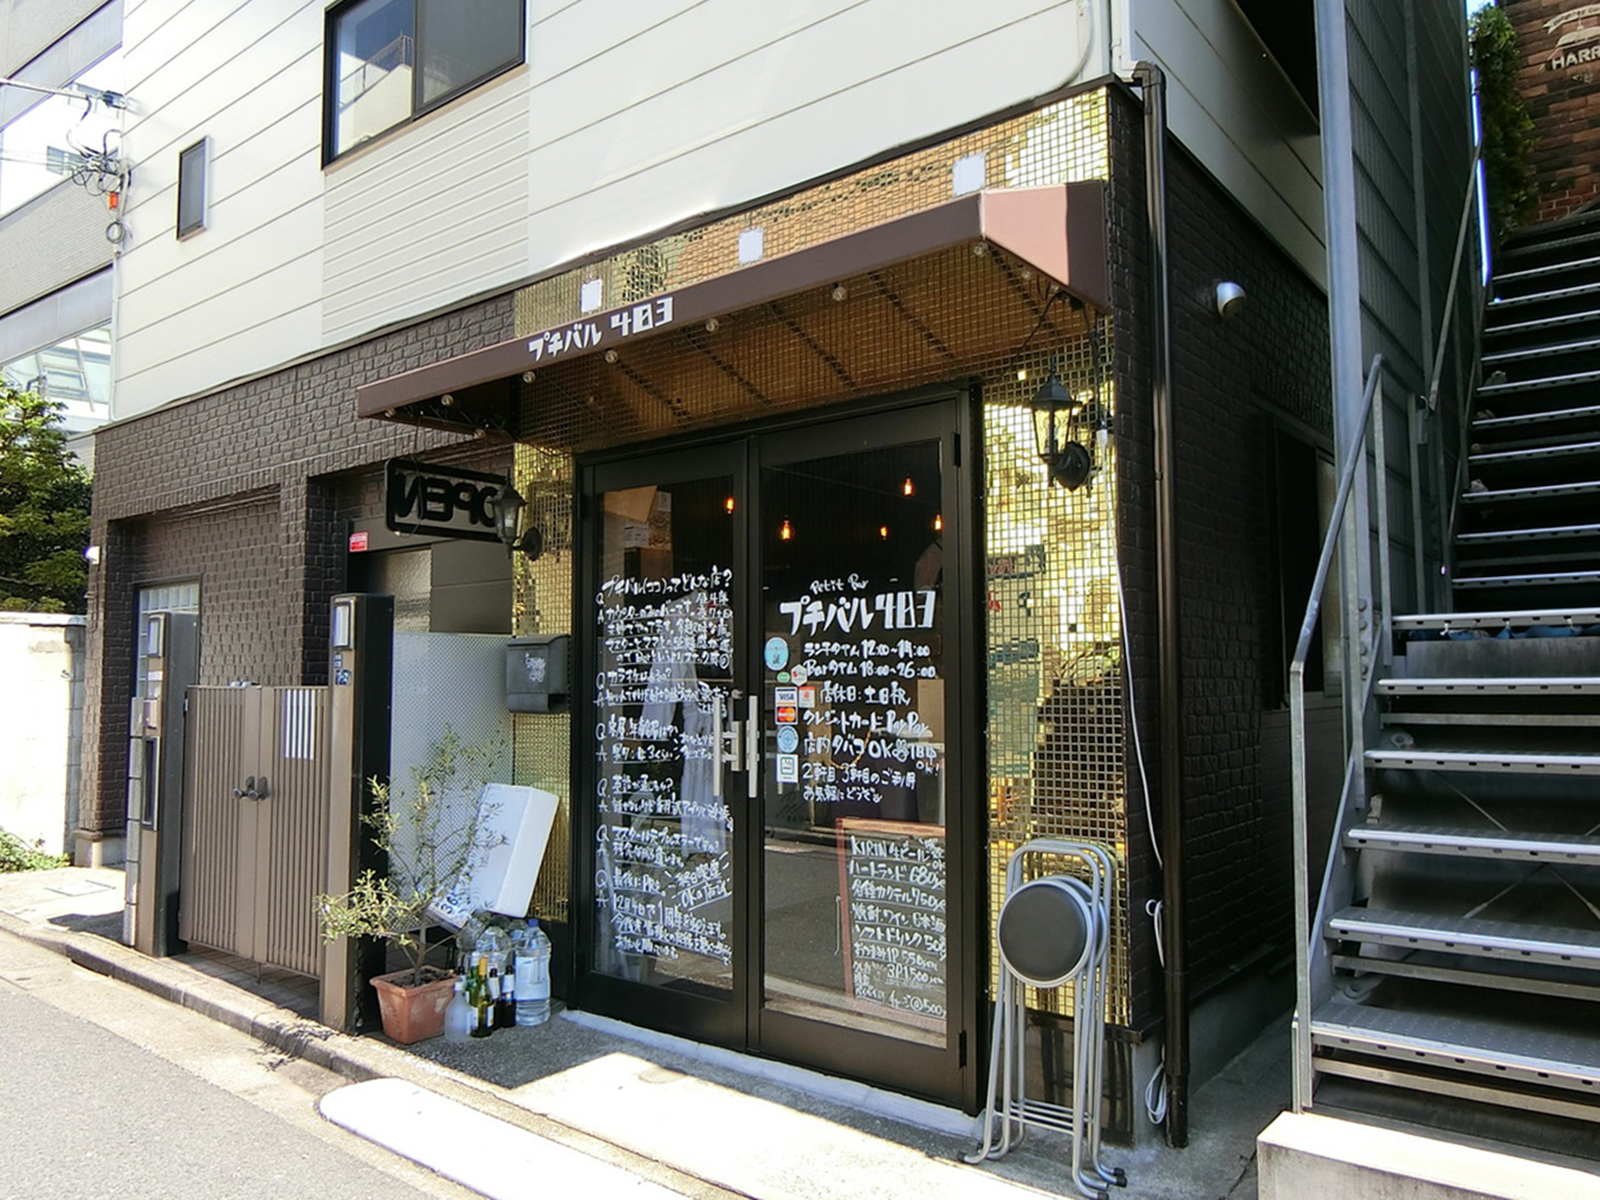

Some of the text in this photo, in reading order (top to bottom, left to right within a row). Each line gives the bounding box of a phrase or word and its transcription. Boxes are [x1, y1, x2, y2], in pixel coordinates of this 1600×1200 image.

[529, 297, 673, 361] プチバル 403
[804, 641, 860, 657] ランチタイム
[778, 693, 795, 701] VISA
